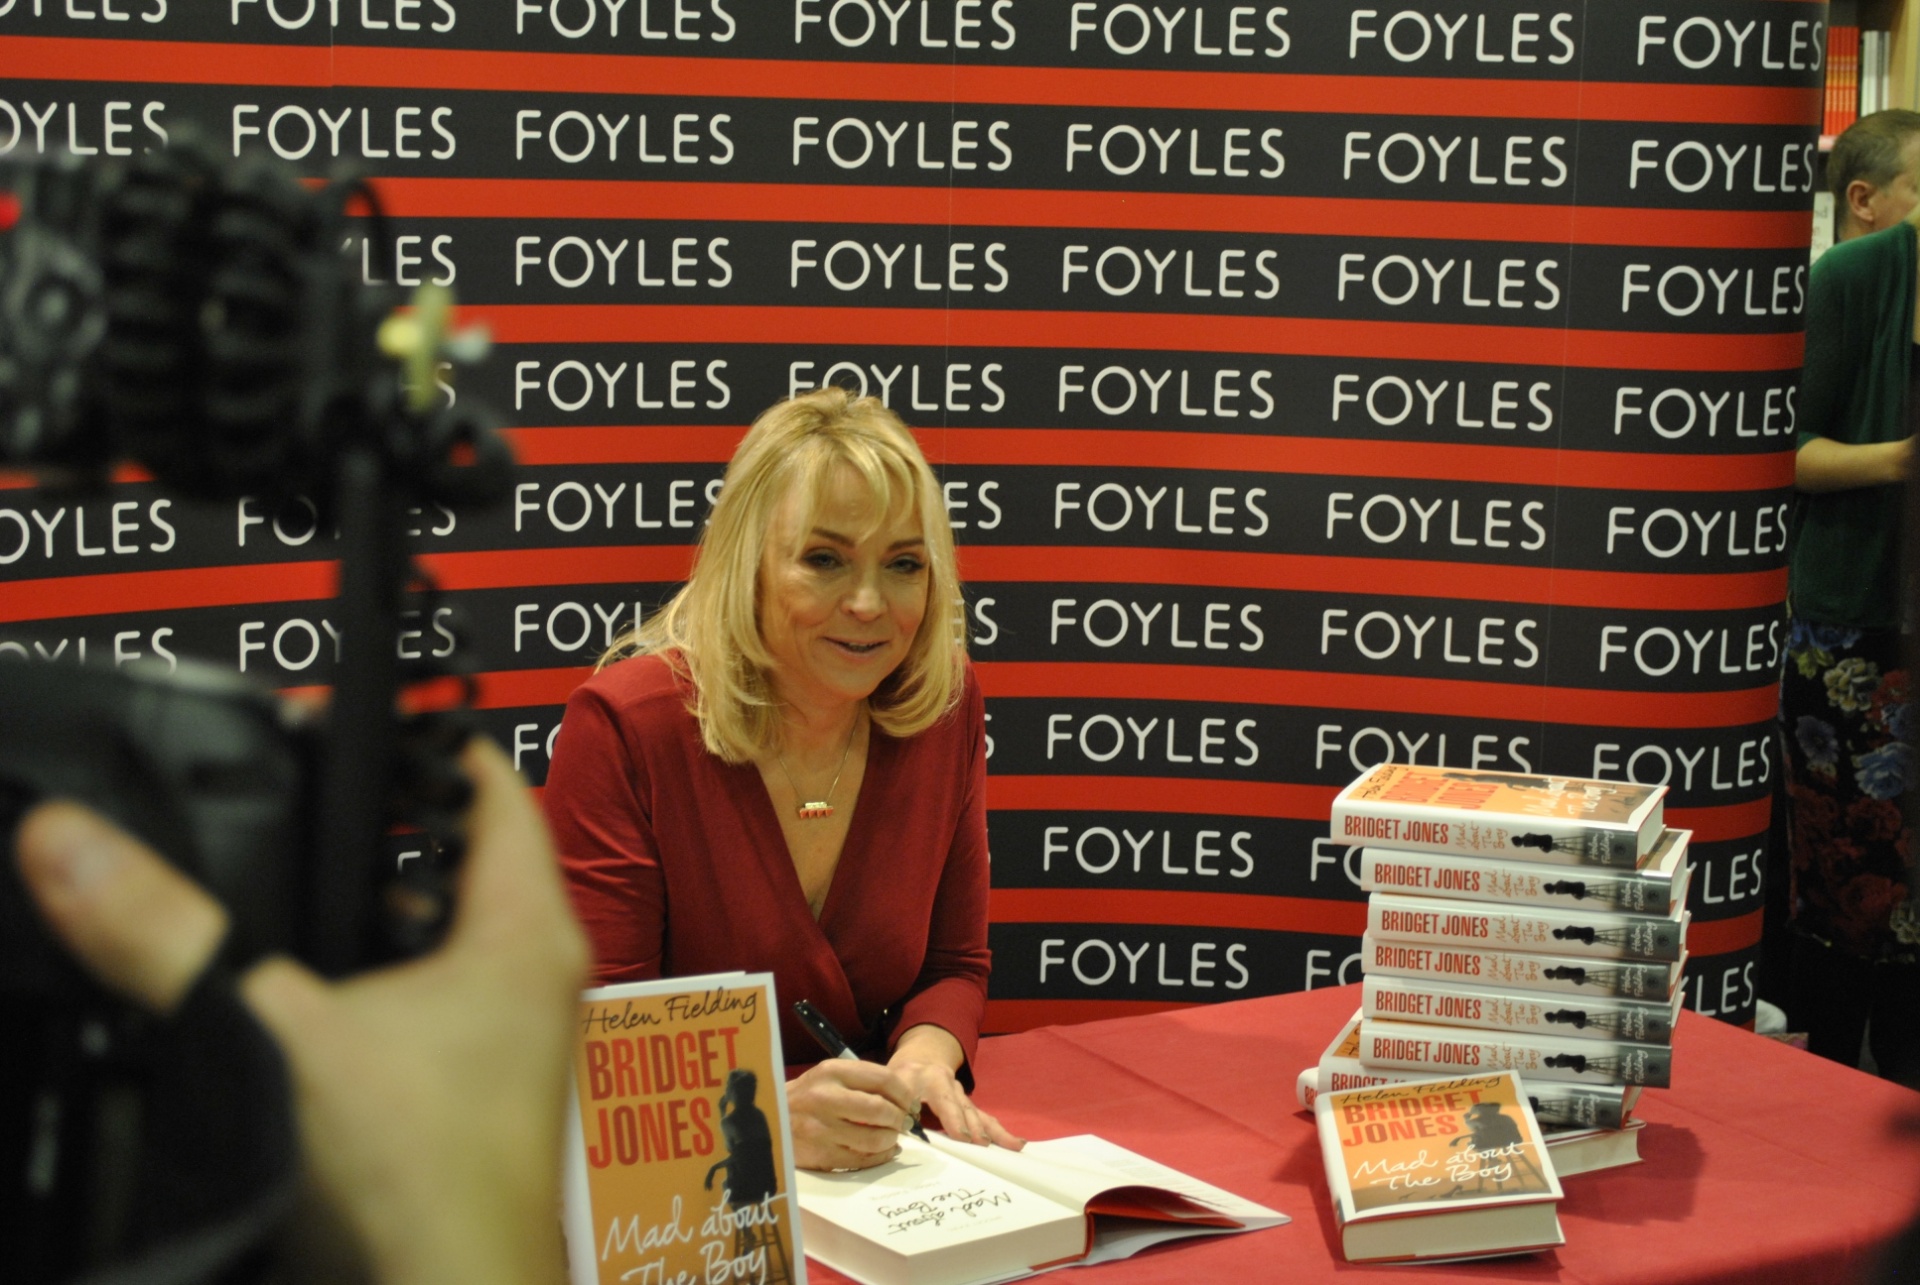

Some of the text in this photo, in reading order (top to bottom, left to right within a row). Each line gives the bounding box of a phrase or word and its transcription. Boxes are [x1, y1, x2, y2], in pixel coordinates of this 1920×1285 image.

[517, 0, 736, 43] FOYLES
[795, 0, 1016, 51] FOYLES
[1070, 2, 1290, 57] FOYLES
[1350, 10, 1575, 65] FOYLES
[1637, 15, 1823, 71] FOYLES
[233, 105, 456, 160] FOYLES
[516, 110, 735, 165] FOYLES
[793, 117, 1013, 171] FOYLES
[1067, 123, 1285, 178] FOYLES
[1344, 131, 1568, 188] FOYLES
[1630, 140, 1814, 193] FOYLES
[515, 236, 733, 288] FOYLES
[790, 240, 1009, 292] FOYLES
[1062, 245, 1280, 300] FOYLES
[1338, 253, 1561, 311] FOYLES
[1622, 264, 1805, 317] FOYLES
[515, 359, 731, 412] FOYLES
[788, 361, 1006, 413] FOYLES
[1058, 365, 1275, 420] FOYLES
[1332, 374, 1553, 432] FOYLES
[1614, 386, 1796, 439] FOYLES
[514, 479, 725, 532] FOYLES
[1055, 482, 1270, 537] FOYLES
[1326, 492, 1546, 551] FOYLES
[1606, 504, 1788, 558] FOYLES
[1051, 598, 1264, 652] FOYLES
[1321, 609, 1539, 668] FOYLES
[1599, 620, 1779, 676] FOYLES
[1047, 714, 1259, 766] FOYLES
[1315, 724, 1532, 774] FOYLES
[1593, 736, 1771, 792] FOYLES
[1044, 826, 1254, 878] FOYLES
[1344, 814, 1449, 845] BRIDGET JONES
[1374, 863, 1481, 892] BRIDGET JONES
[1382, 910, 1489, 939] BRIDGET JONES
[1040, 938, 1249, 989] FOYLES
[1375, 946, 1433, 971] BRIDGET
[1435, 952, 1481, 976] JONES
[582, 986, 758, 1034] Helen Fielding
[1376, 990, 1482, 1020] BRIDGET JONES
[585, 1026, 740, 1101] BRIDGET
[1373, 1037, 1432, 1062] BRIDGET
[1433, 1043, 1481, 1067] JONES
[1341, 1076, 1501, 1105] Helen Fielding
[1342, 1089, 1483, 1125] BRIDGET
[588, 1096, 715, 1170] JONES
[1342, 1114, 1460, 1147] JONES
[1353, 1141, 1535, 1180] Mad about
[1369, 1162, 1513, 1191] The Boy
[602, 1188, 788, 1261] Mad about
[620, 1240, 766, 1285] The Boy
